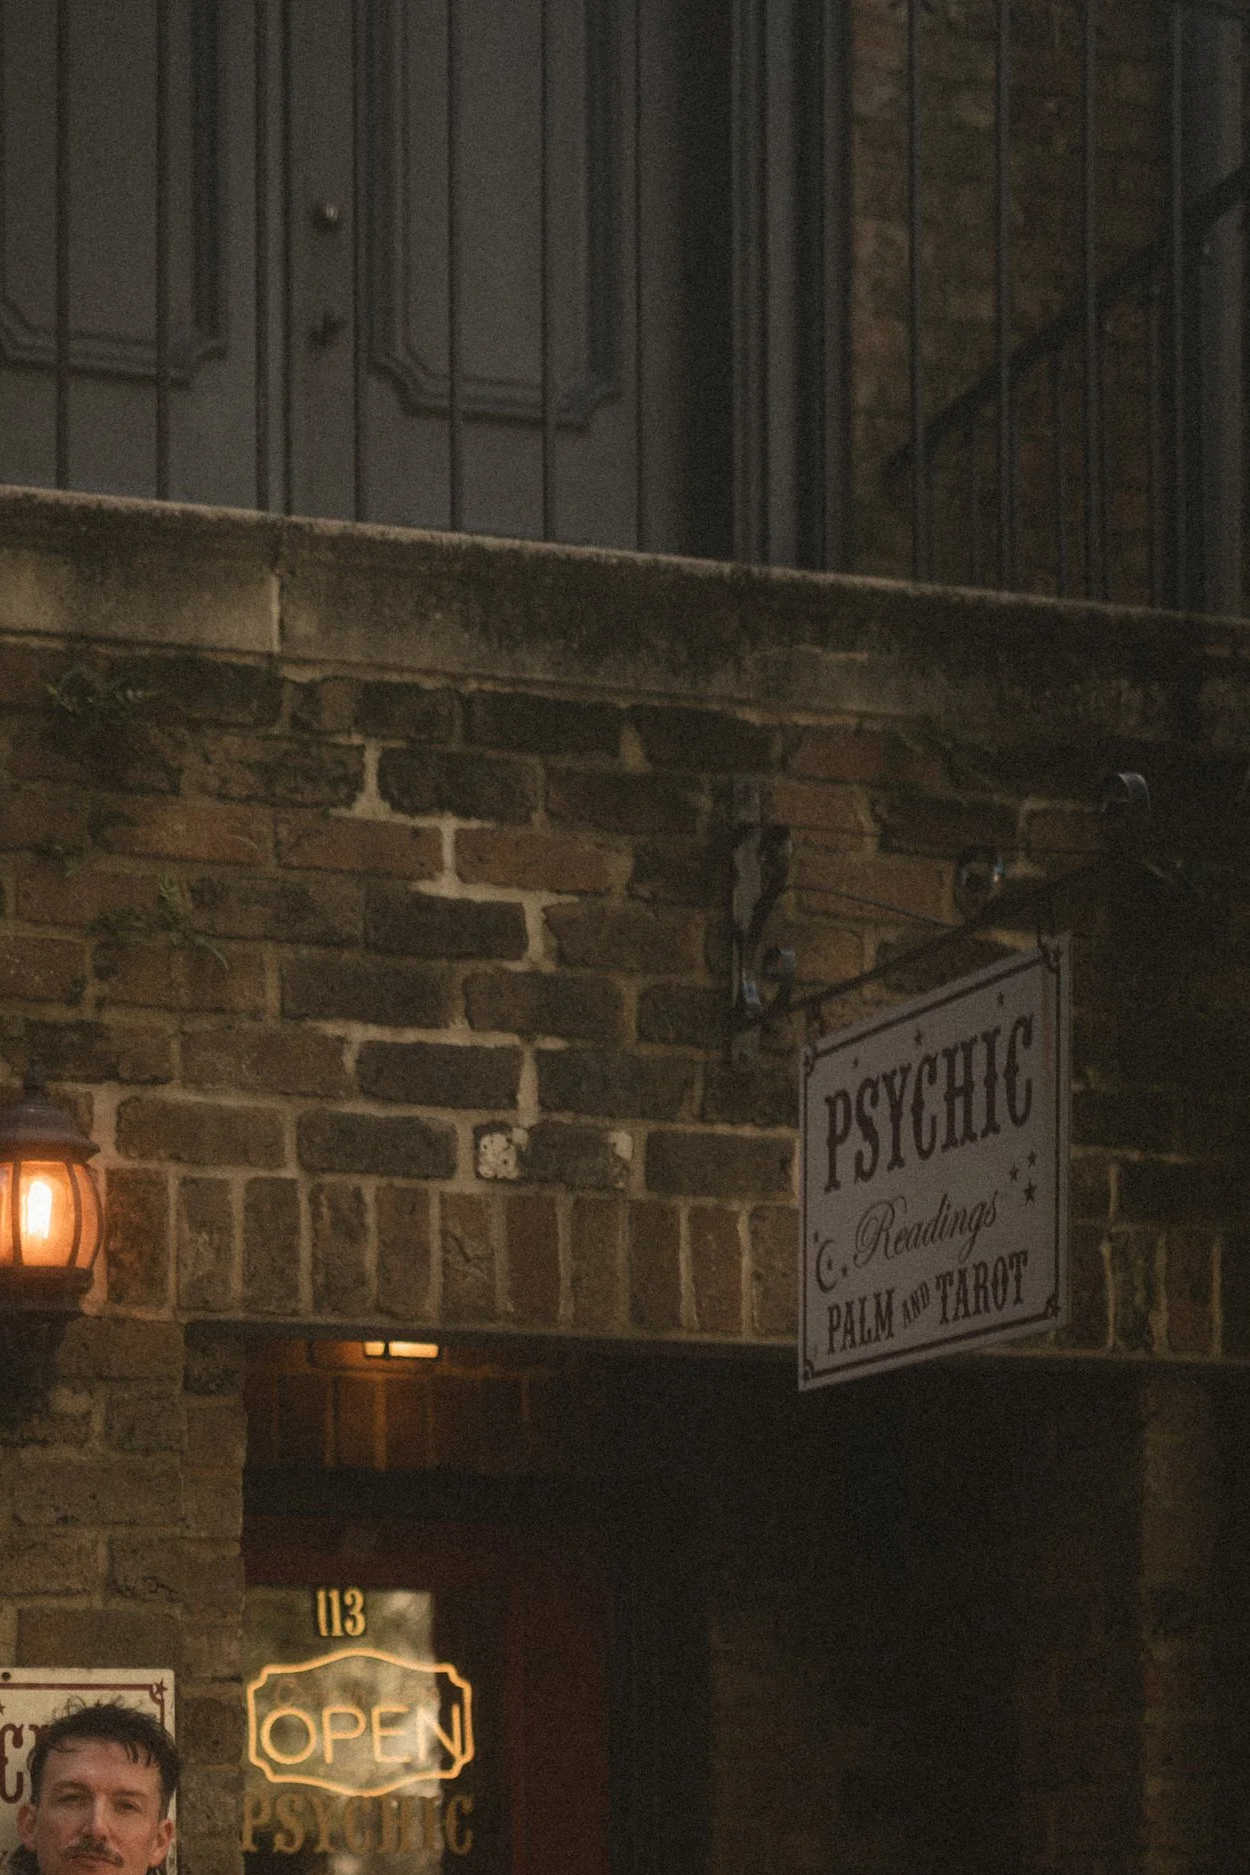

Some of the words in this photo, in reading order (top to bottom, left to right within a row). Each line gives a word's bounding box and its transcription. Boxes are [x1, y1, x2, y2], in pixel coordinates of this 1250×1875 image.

[824, 1012, 1034, 1194] PSYCHIC
[853, 1190, 999, 1269] Readings
[827, 1287, 895, 1355] PALM
[902, 1281, 930, 1330] AND
[935, 1250, 1030, 1326] TAROT
[317, 1586, 367, 1637] 113
[260, 1703, 463, 1765] OPEN
[241, 1792, 475, 1856] PSYCHIC
